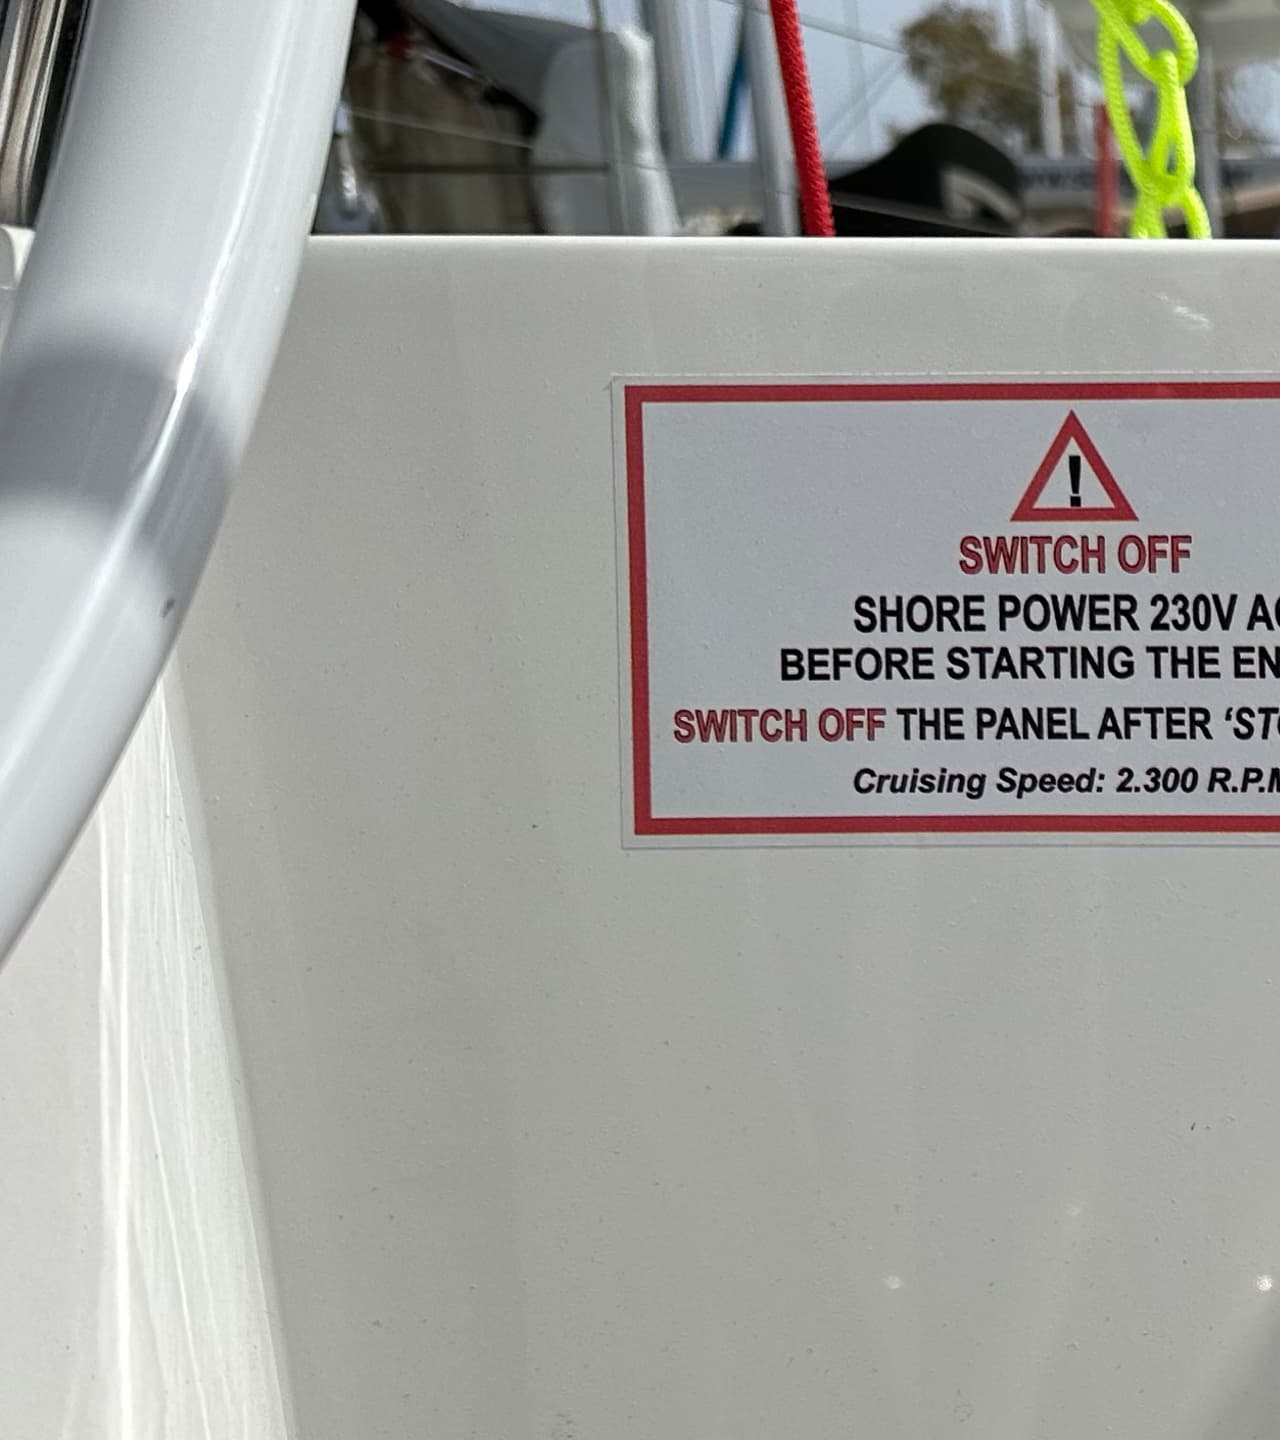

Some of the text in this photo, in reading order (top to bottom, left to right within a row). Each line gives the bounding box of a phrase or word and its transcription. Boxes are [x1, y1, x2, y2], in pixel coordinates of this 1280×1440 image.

[958, 534, 1193, 575] SWITCH OFF
[853, 594, 987, 634] SHORE
[998, 593, 1141, 632] POWER
[1150, 593, 1239, 632] 230V
[780, 646, 936, 682] BEFORE
[946, 645, 1135, 681] STARTING
[1145, 645, 1222, 680] THE
[673, 708, 808, 744] SWITCH
[818, 707, 887, 743] OFF
[895, 707, 966, 741] THE
[975, 706, 1091, 741] PANEL
[1096, 706, 1214, 741] AFTER
[853, 767, 987, 800] Cruising
[995, 766, 1106, 800] Speed:
[1115, 766, 1199, 794] 2.300
